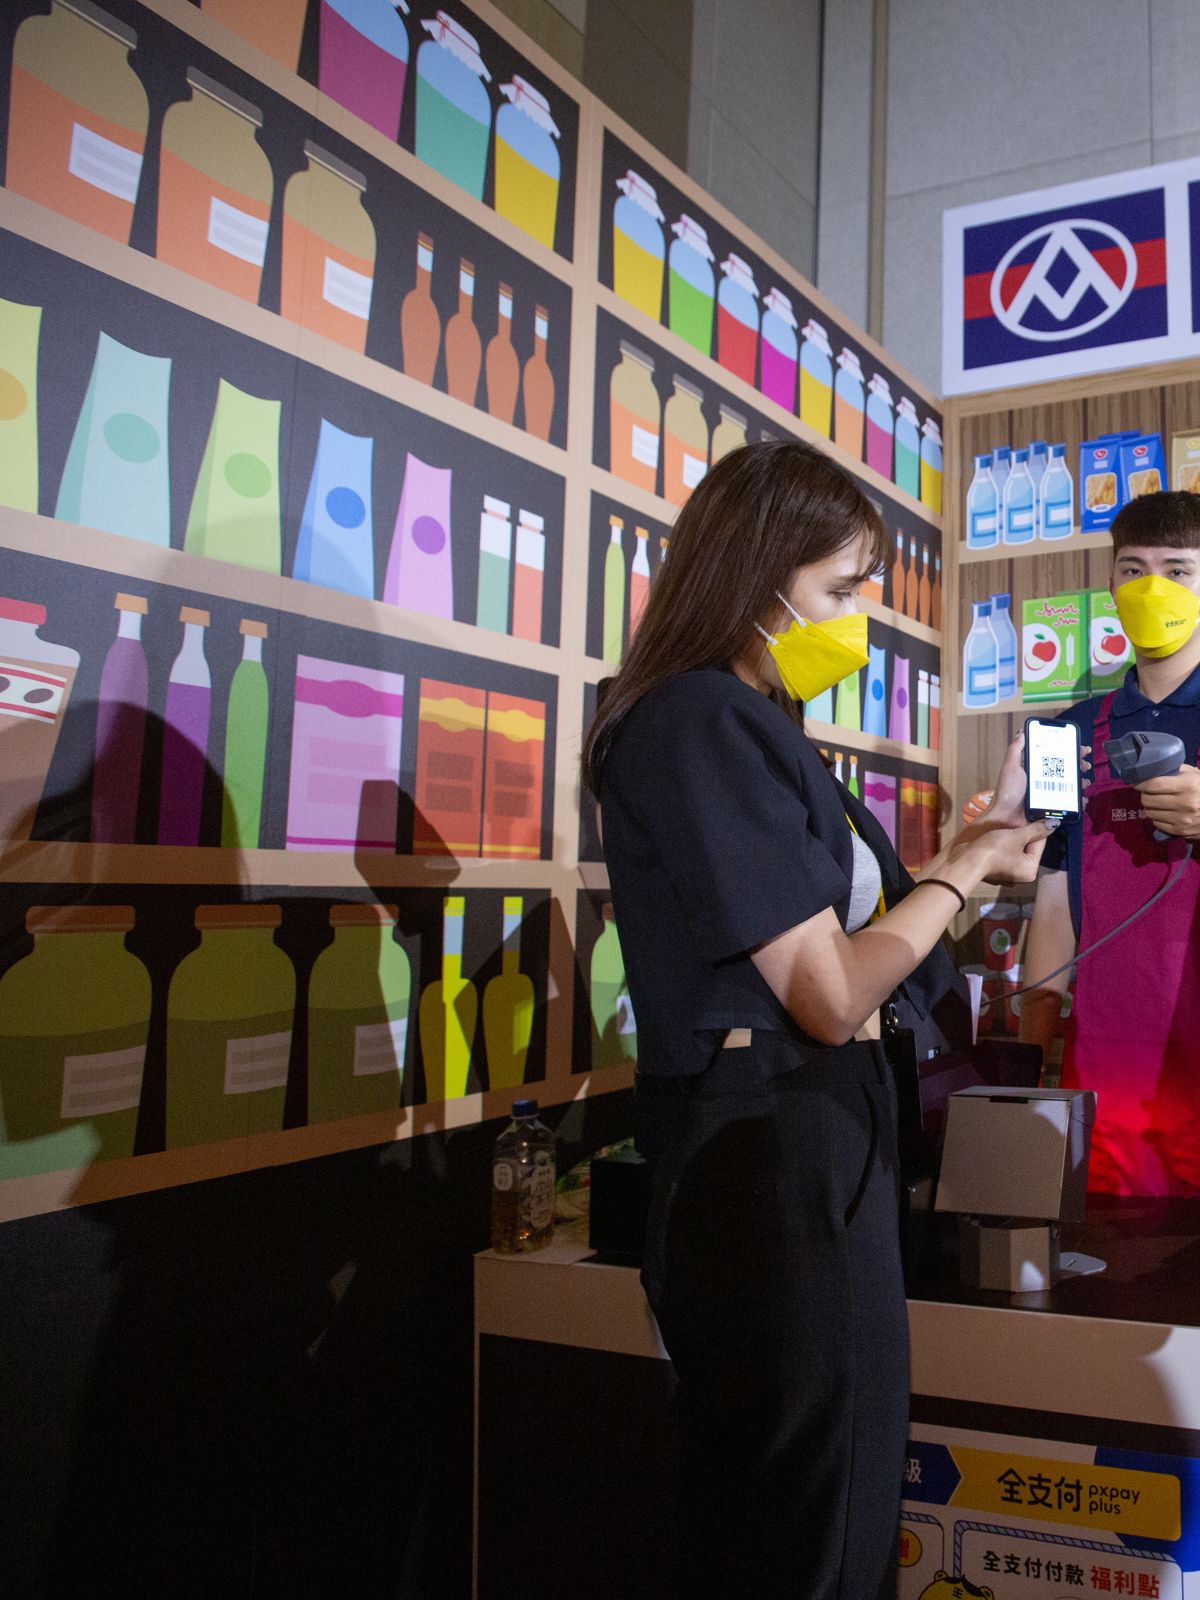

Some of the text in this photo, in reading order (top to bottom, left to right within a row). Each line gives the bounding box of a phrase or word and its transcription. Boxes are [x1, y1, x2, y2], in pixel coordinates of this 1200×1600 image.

[996, 1467, 1083, 1513] 全支付
[1088, 1482, 1141, 1505] pxpay
[1088, 1500, 1122, 1515] plus
[983, 1550, 1160, 1599] 全支付付款 福利點
